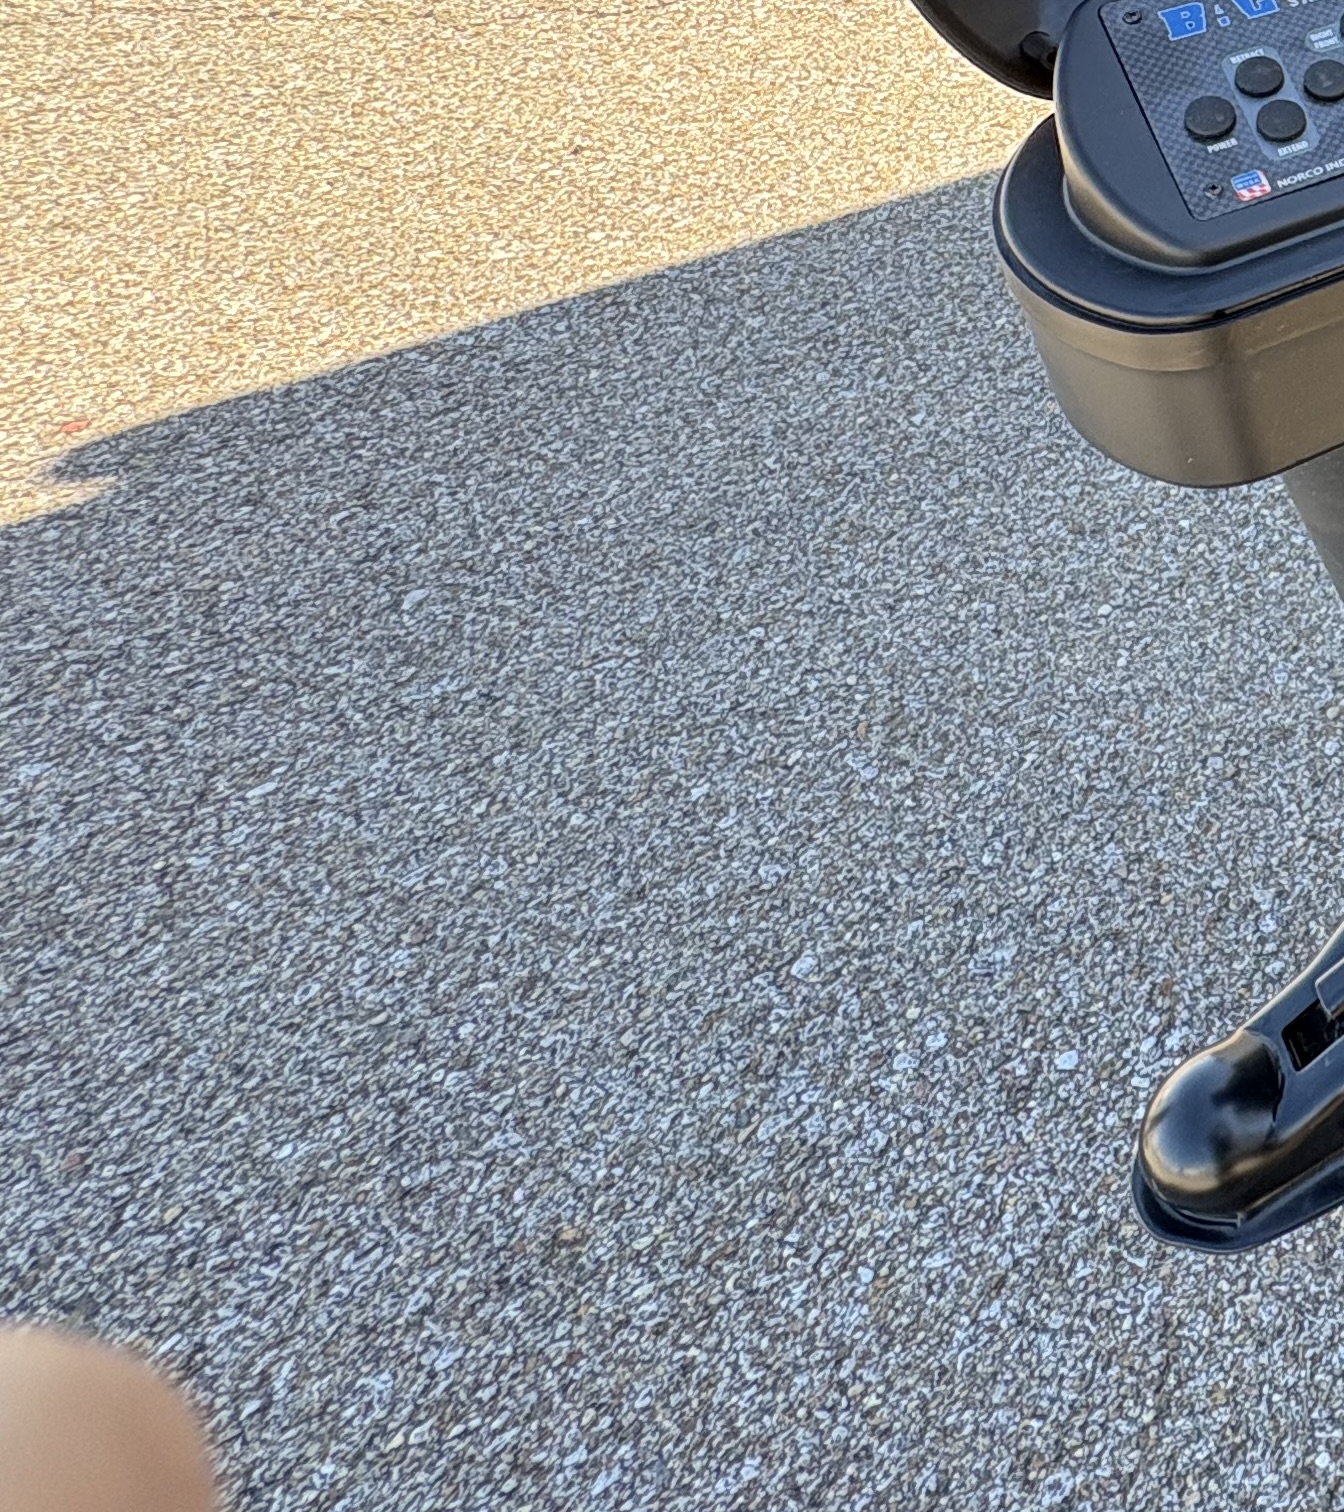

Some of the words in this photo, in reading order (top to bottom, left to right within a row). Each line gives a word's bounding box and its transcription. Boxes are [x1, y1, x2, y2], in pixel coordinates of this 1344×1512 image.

[1207, 138, 1238, 153] POWER
[1277, 141, 1309, 156] EXTEND
[1277, 167, 1324, 188] NORCO
